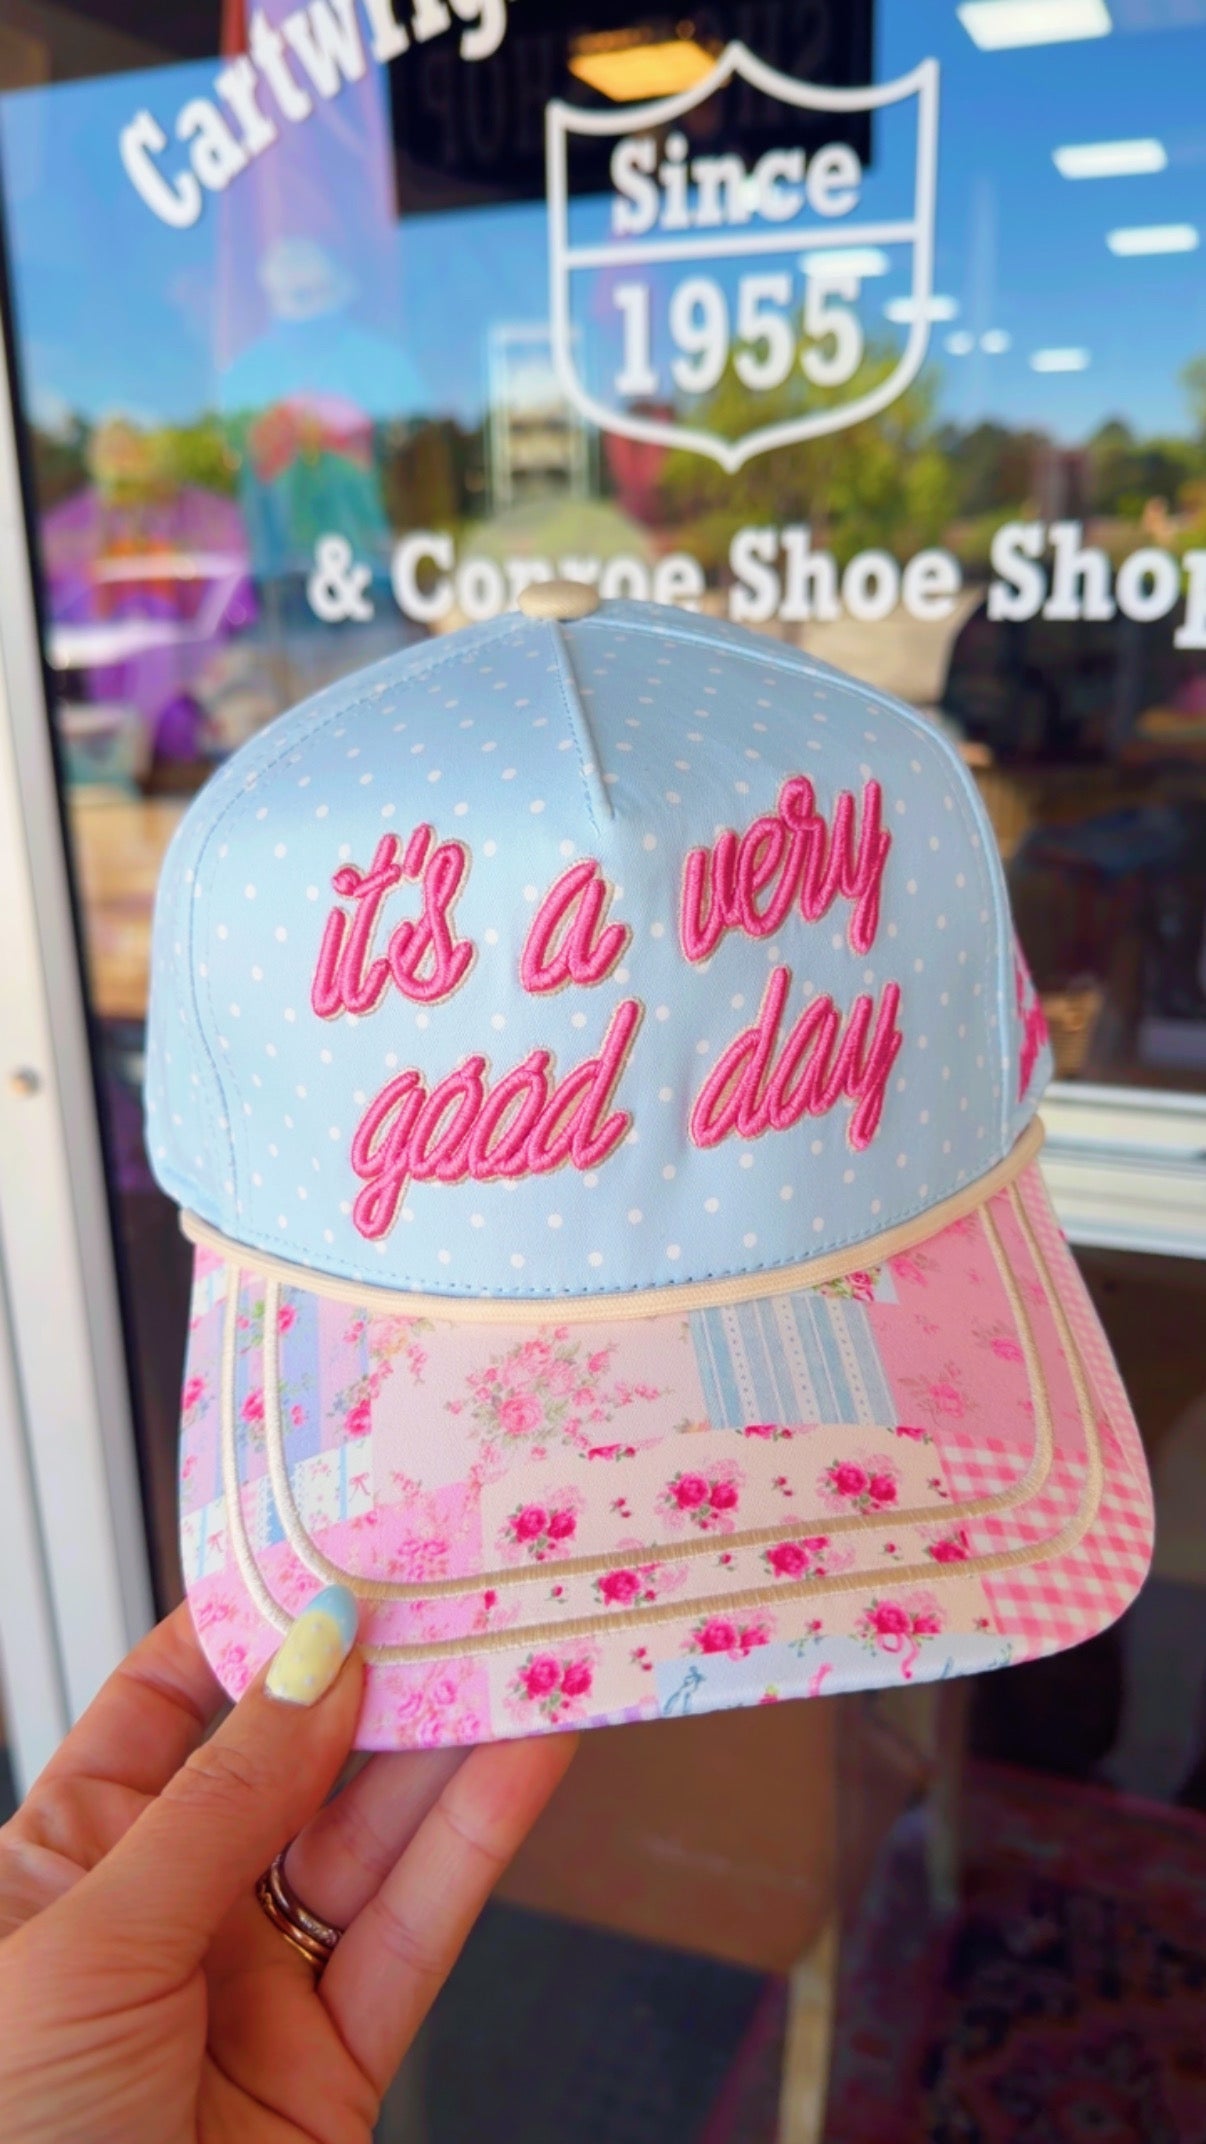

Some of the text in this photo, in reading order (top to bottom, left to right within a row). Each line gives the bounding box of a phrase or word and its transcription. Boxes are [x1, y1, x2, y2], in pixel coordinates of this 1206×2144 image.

[610, 132, 862, 235] Since
[613, 271, 864, 394] 1955
[307, 533, 374, 622] &
[728, 523, 961, 621] Shoe
[312, 774, 892, 1020] it's a very
[350, 998, 642, 1242] good
[689, 964, 903, 1152] day
